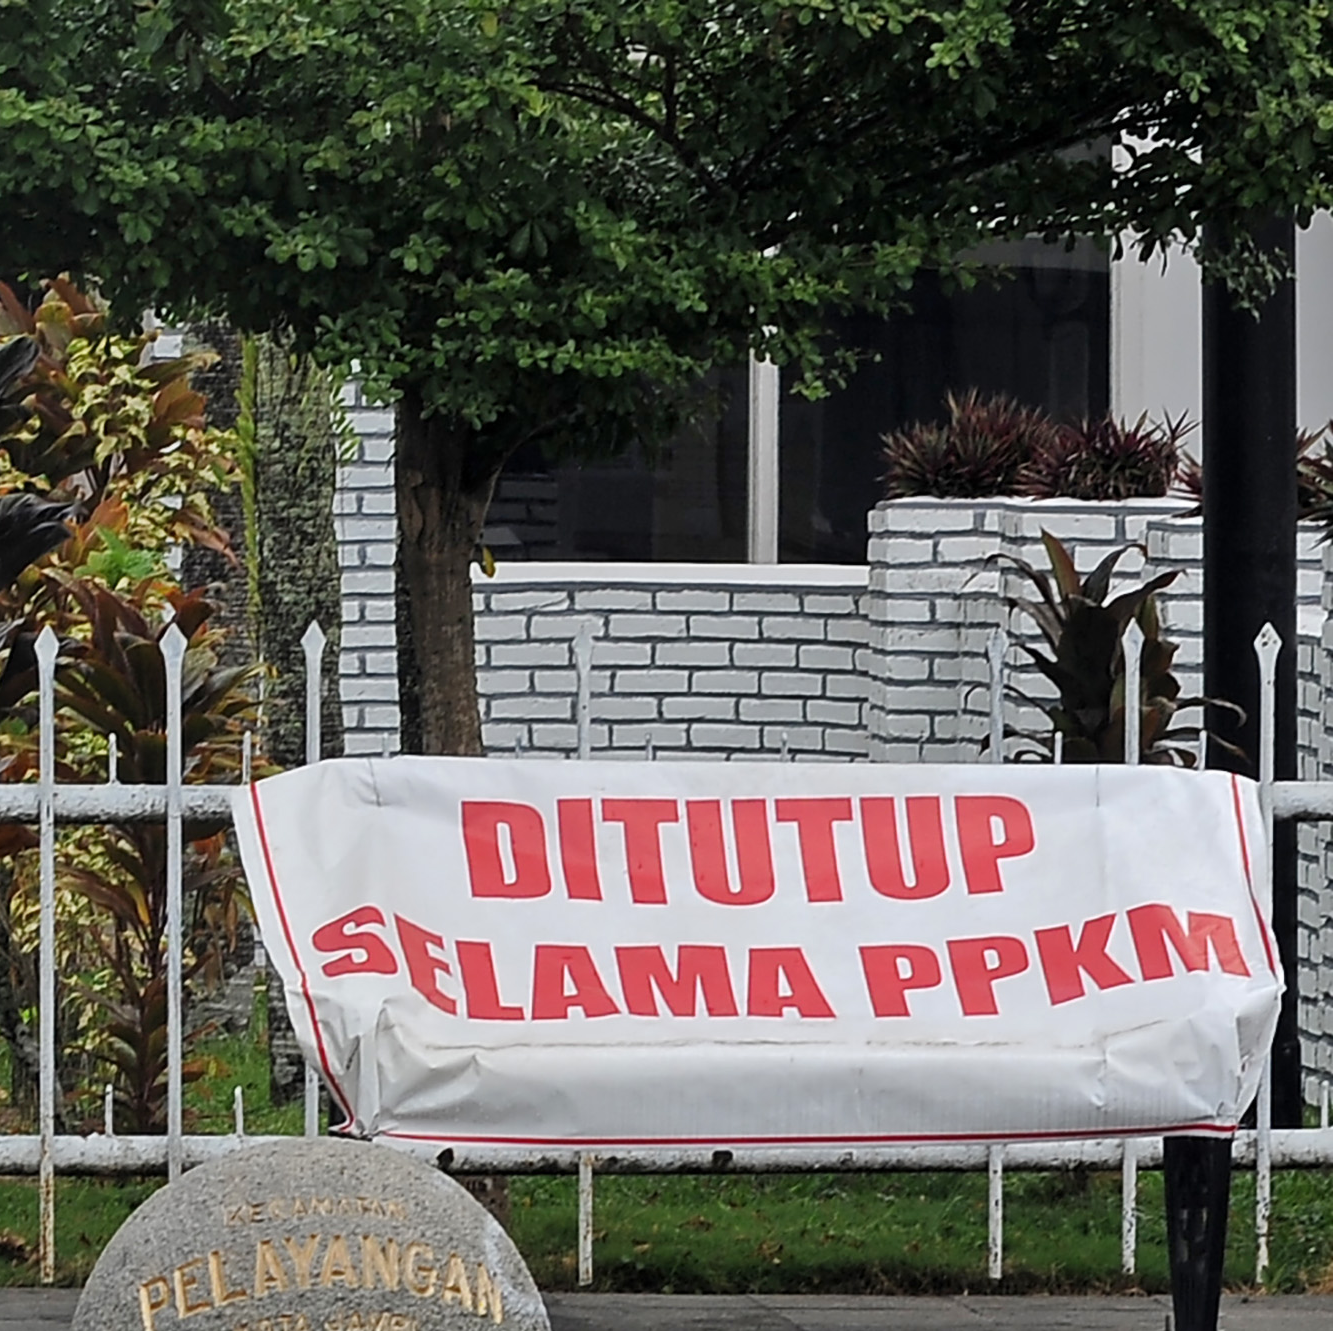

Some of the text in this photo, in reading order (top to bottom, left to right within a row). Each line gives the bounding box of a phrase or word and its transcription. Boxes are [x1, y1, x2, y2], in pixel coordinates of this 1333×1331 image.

[460, 795, 1036, 906] DITUTUP
[311, 902, 1252, 1021] SELAMA PPKM
